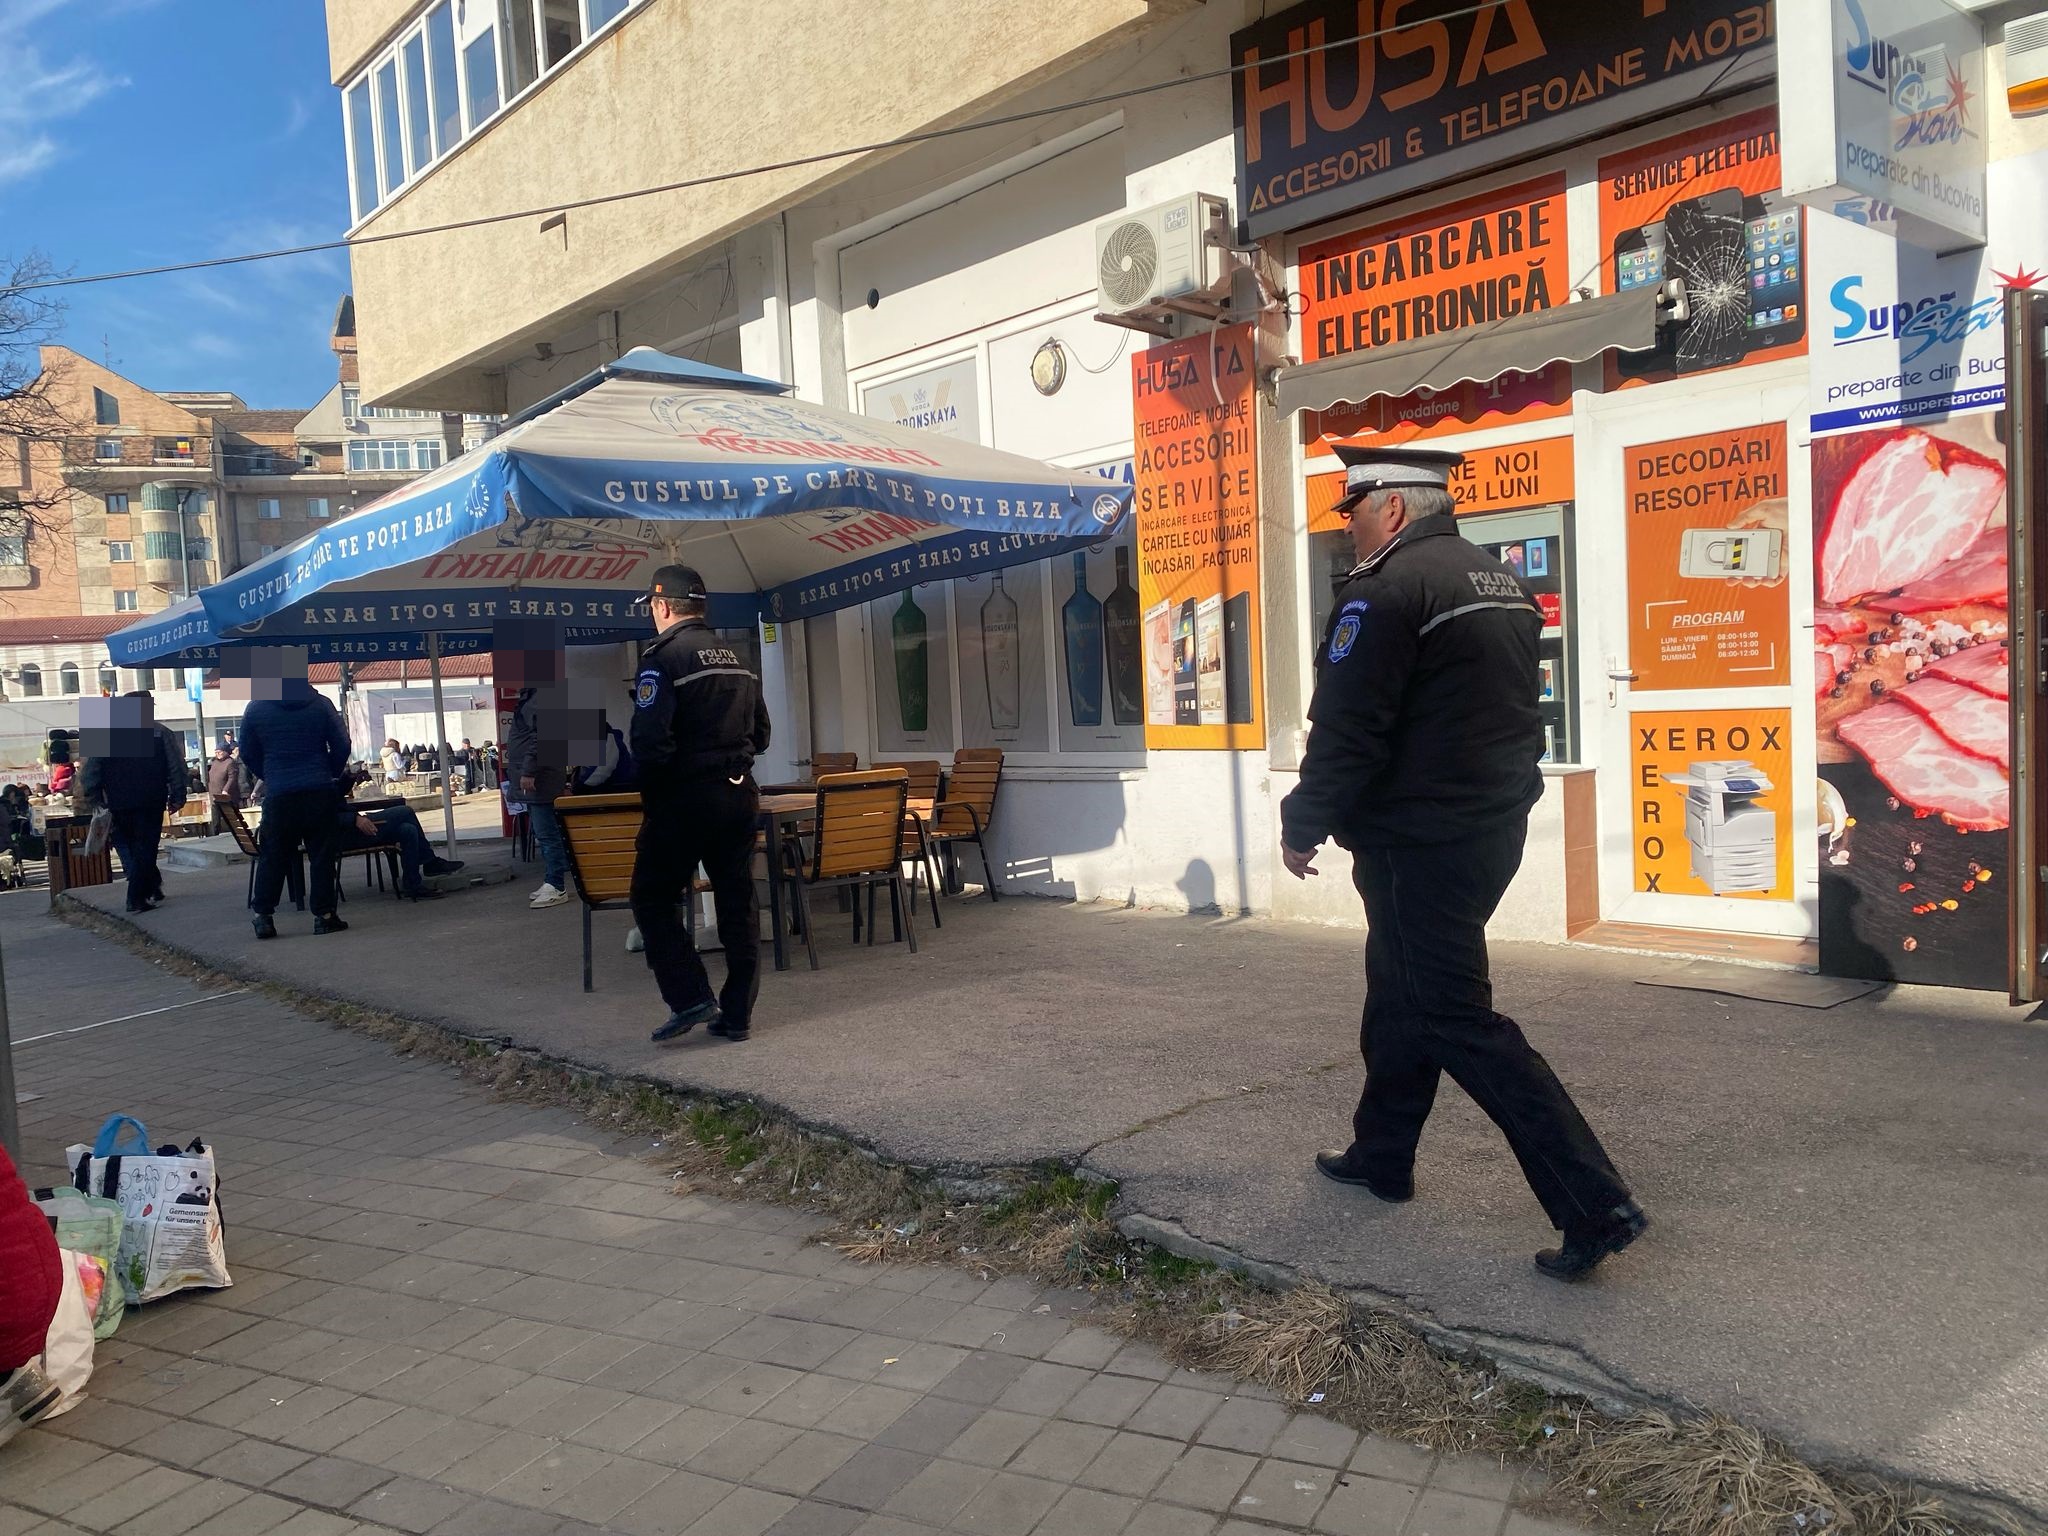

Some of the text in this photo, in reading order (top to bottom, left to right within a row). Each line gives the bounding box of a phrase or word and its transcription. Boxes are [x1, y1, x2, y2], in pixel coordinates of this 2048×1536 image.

[1244, 0, 1547, 165] HUSA
[1249, 137, 1391, 213] ACCESORII
[1405, 127, 1425, 159] &
[1440, 47, 1647, 146] TELEFOANE
[1612, 154, 1688, 201] SERVICE
[1846, 140, 1909, 187] preparate
[1911, 165, 1930, 195] din
[1933, 173, 1981, 217] Bucovina
[1317, 256, 1552, 360] ELECTRONICĂ
[1829, 275, 1957, 340] Super
[1137, 354, 1199, 398] HUSA
[1828, 370, 1923, 403] preparate
[1929, 363, 1962, 382] din
[1140, 399, 1249, 438] TELEFOANE MOBILE
[1328, 401, 1369, 418] orange
[1399, 399, 1460, 420] vodafone
[1141, 428, 1249, 475] ACCESORII
[1495, 450, 1539, 476] NOI
[1638, 437, 1771, 481] DECODĂRI
[604, 479, 739, 505] GUSTUL
[752, 475, 793, 497] PE
[806, 468, 878, 492] CARE
[887, 478, 915, 503] TE
[997, 499, 1063, 520] BAZA
[1142, 469, 1250, 512] SERVICE
[1485, 475, 1539, 501] LUNI
[1634, 471, 1778, 514] RESOFTĂRI
[1141, 502, 1252, 532] ÎNCĂRCARE ELECTRONICĂ
[1142, 519, 1252, 553] CARTELE CU NUMĂR
[238, 573, 292, 610] GUSTUL
[296, 558, 312, 585] PE
[338, 536, 360, 559] TE
[414, 501, 453, 538] BAZA
[1143, 547, 1253, 577] ÎNCASĂRI FACTURI
[127, 619, 209, 654] GUSTUL PE CARE TE
[1660, 637, 1678, 645] LUNI
[1683, 634, 1709, 643] VINERI
[1672, 610, 1746, 628] PROGRAM
[1640, 727, 1782, 752] XEROX
[176, 1217, 201, 1225] unsere
